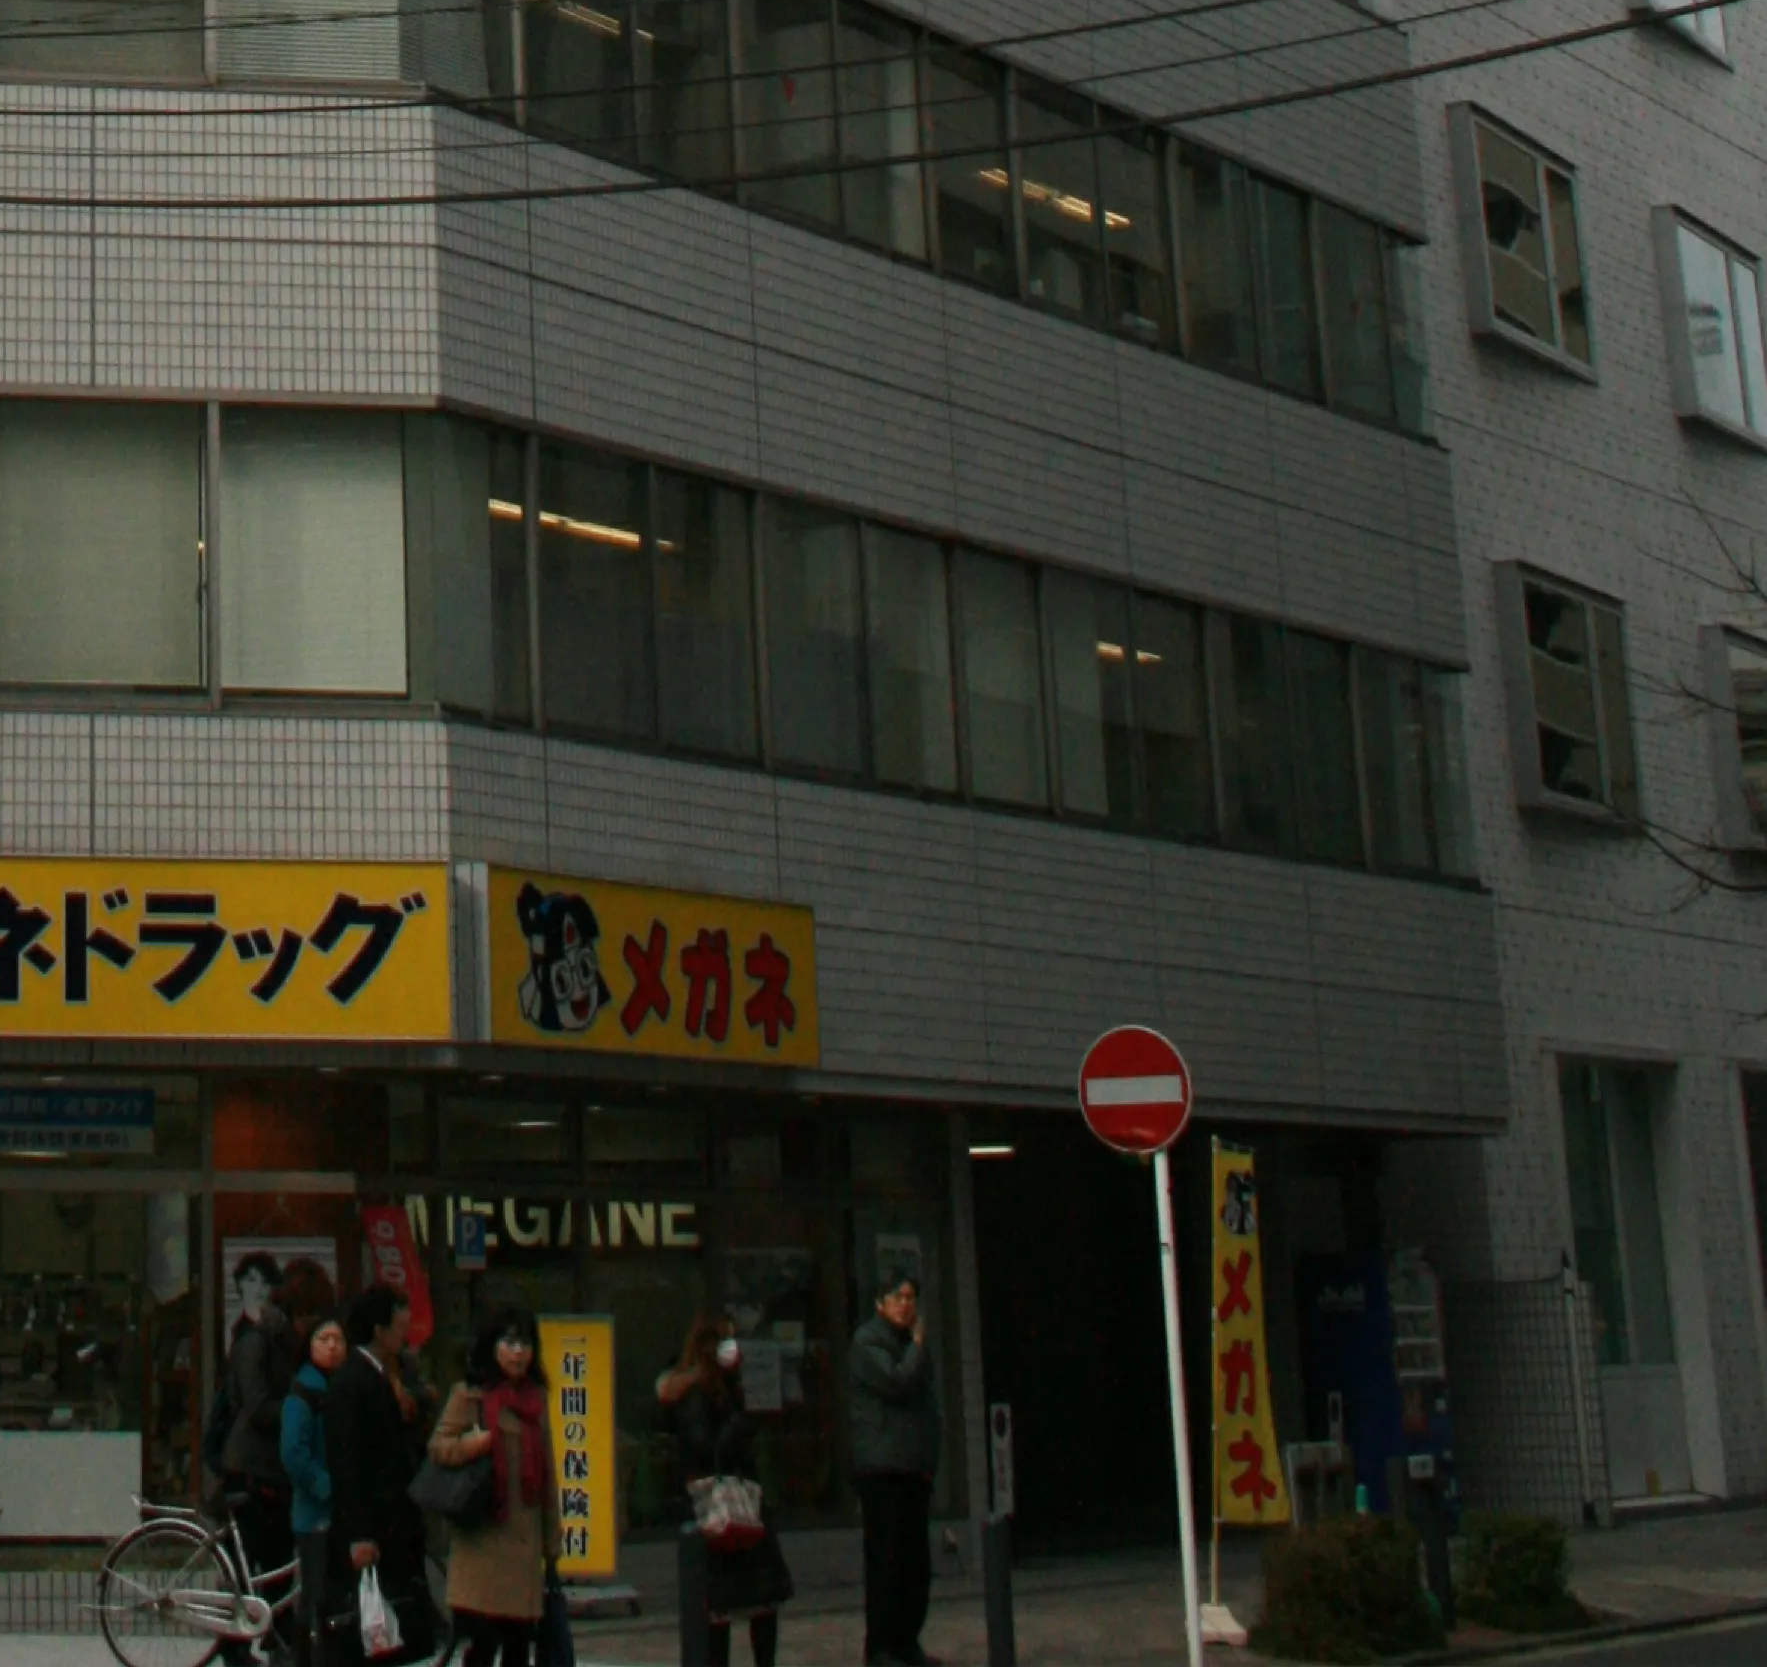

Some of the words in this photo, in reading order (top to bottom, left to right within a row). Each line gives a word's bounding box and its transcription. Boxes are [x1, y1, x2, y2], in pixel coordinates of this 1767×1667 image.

[619, 917, 796, 1048] メガネ
[1216, 1249, 1278, 1514] メガネ
